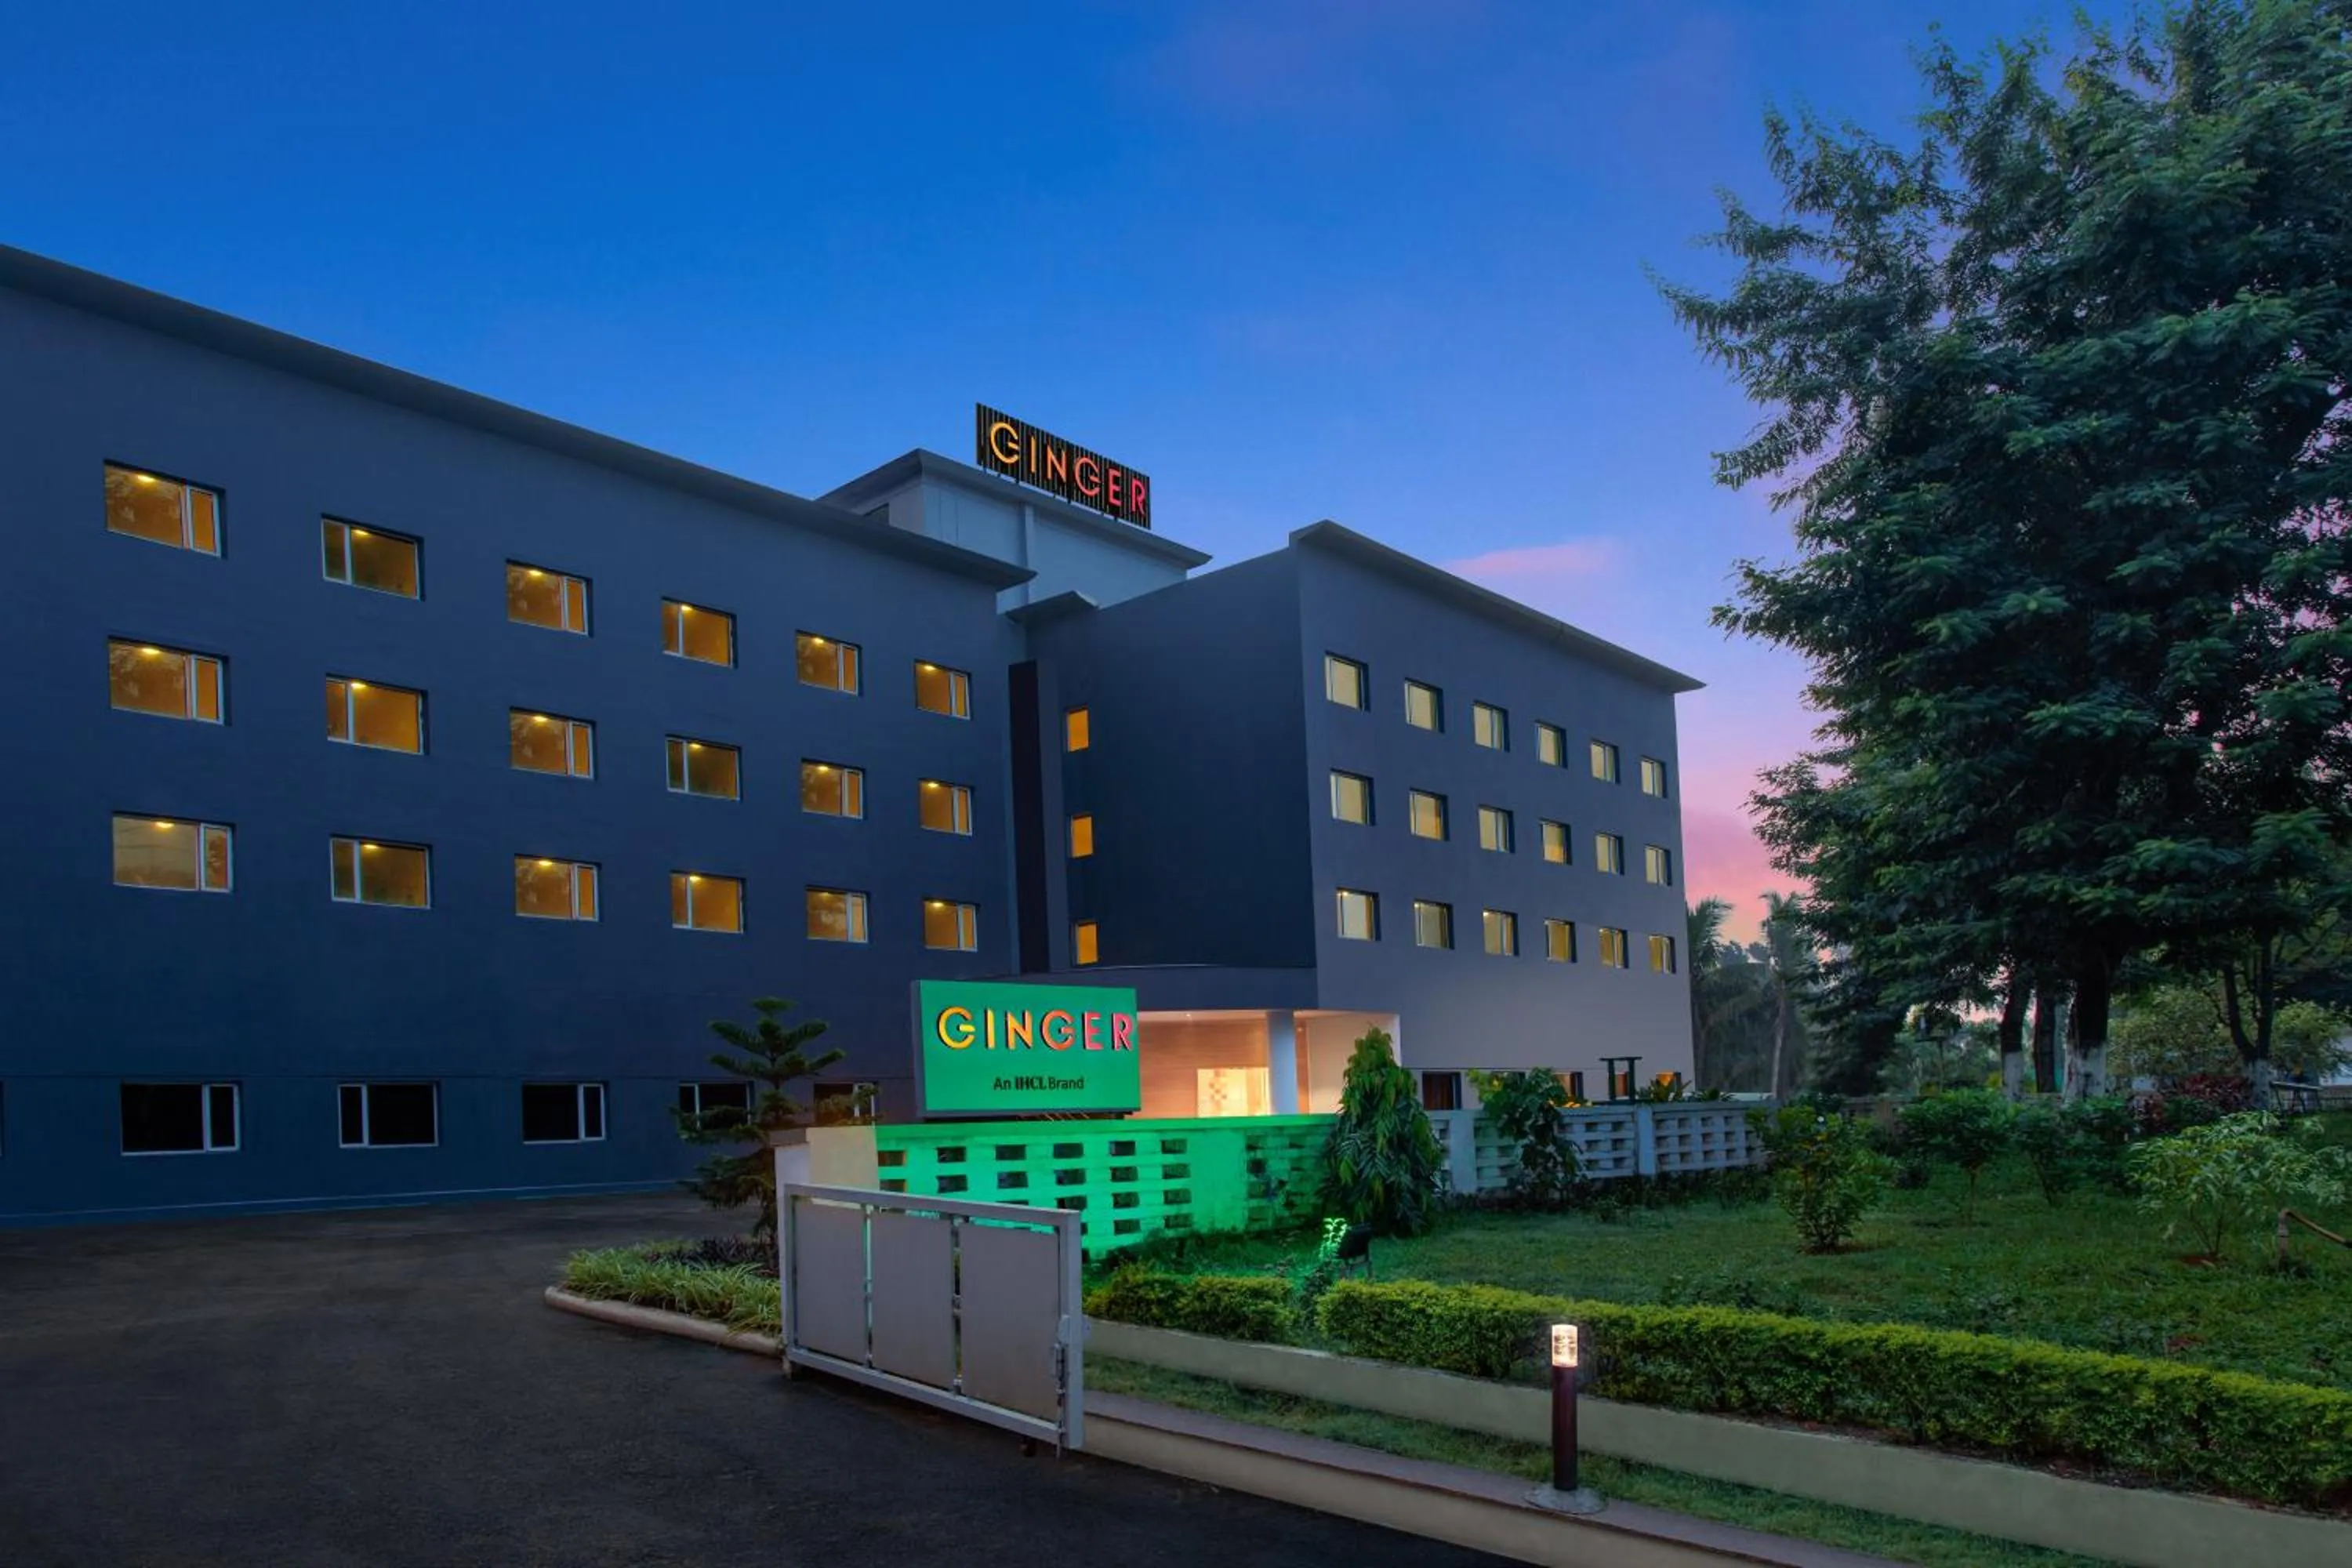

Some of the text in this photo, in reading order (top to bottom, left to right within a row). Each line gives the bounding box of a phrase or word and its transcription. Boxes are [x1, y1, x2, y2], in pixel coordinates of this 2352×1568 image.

[989, 422, 1146, 516] GINGER
[938, 1006, 1134, 1051] GINGER
[993, 1076, 1085, 1091] An IHCL Brand
